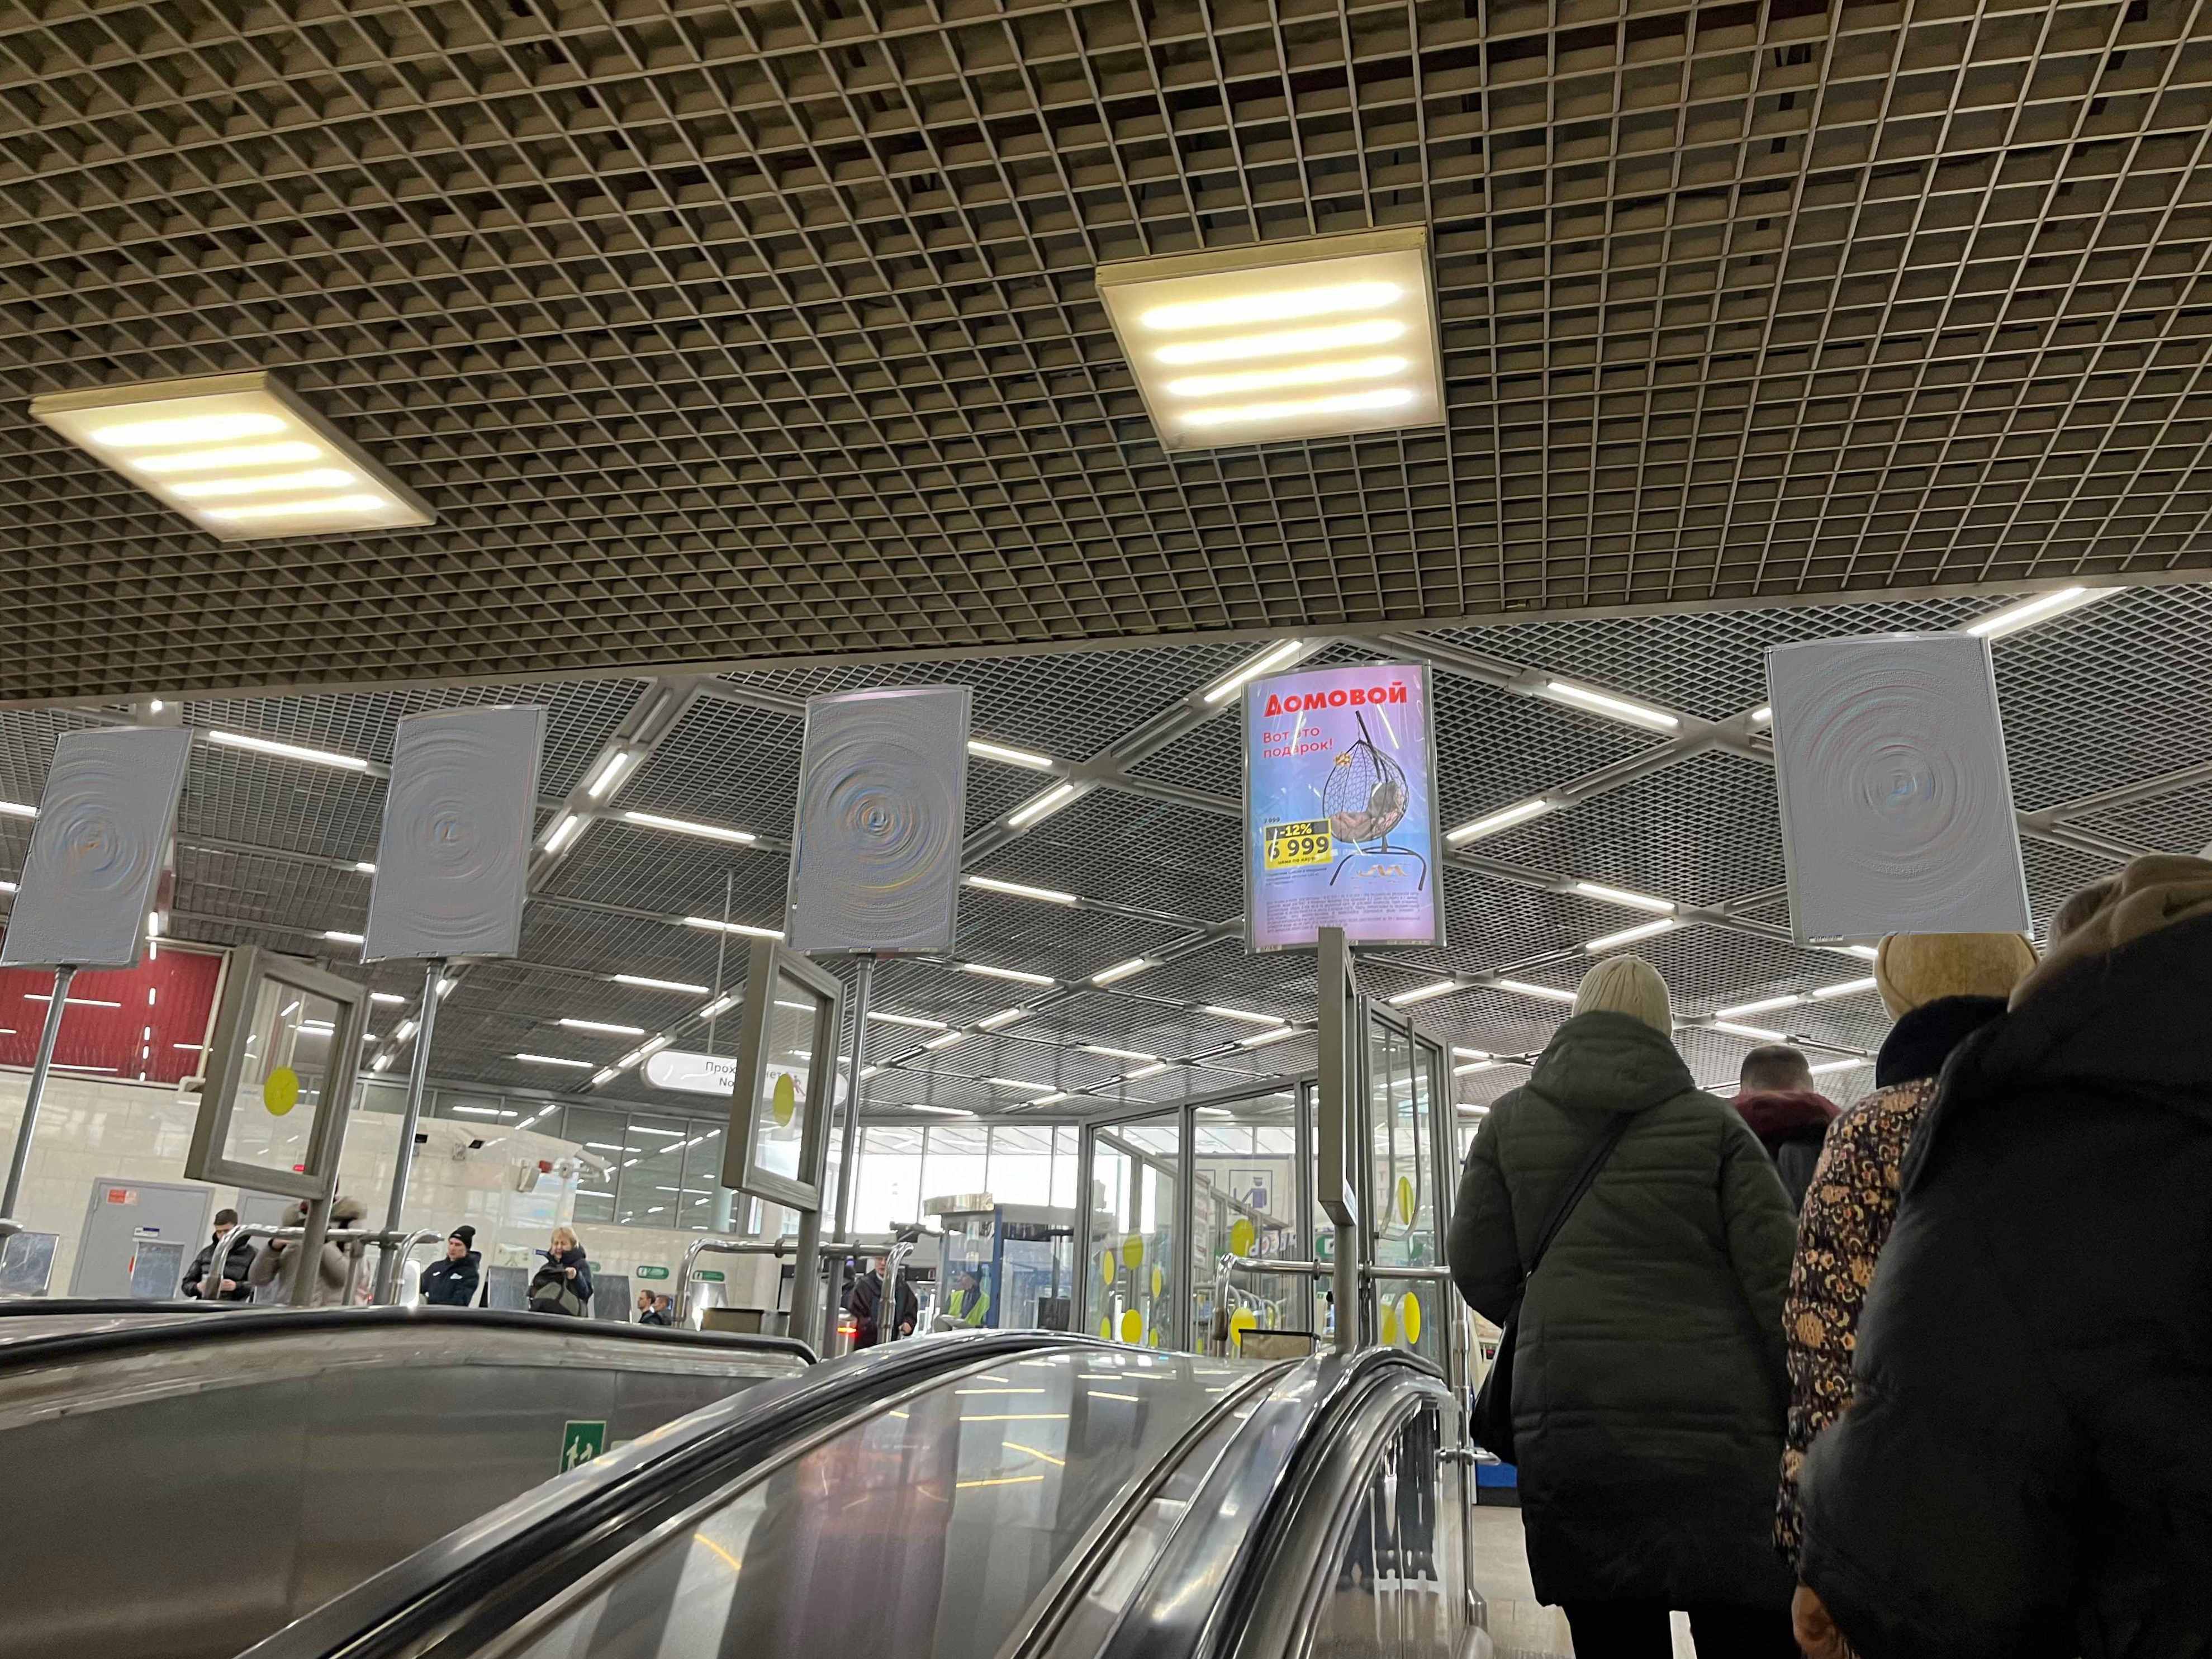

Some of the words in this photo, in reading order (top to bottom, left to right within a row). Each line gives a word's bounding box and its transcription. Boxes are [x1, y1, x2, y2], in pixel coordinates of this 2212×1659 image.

[1263, 731, 1289, 743] Вот
[1280, 823, 1312, 836] -12%
[1287, 836, 1329, 856] 999
[705, 1061, 737, 1074] Прох
[719, 1077, 735, 1087] No
